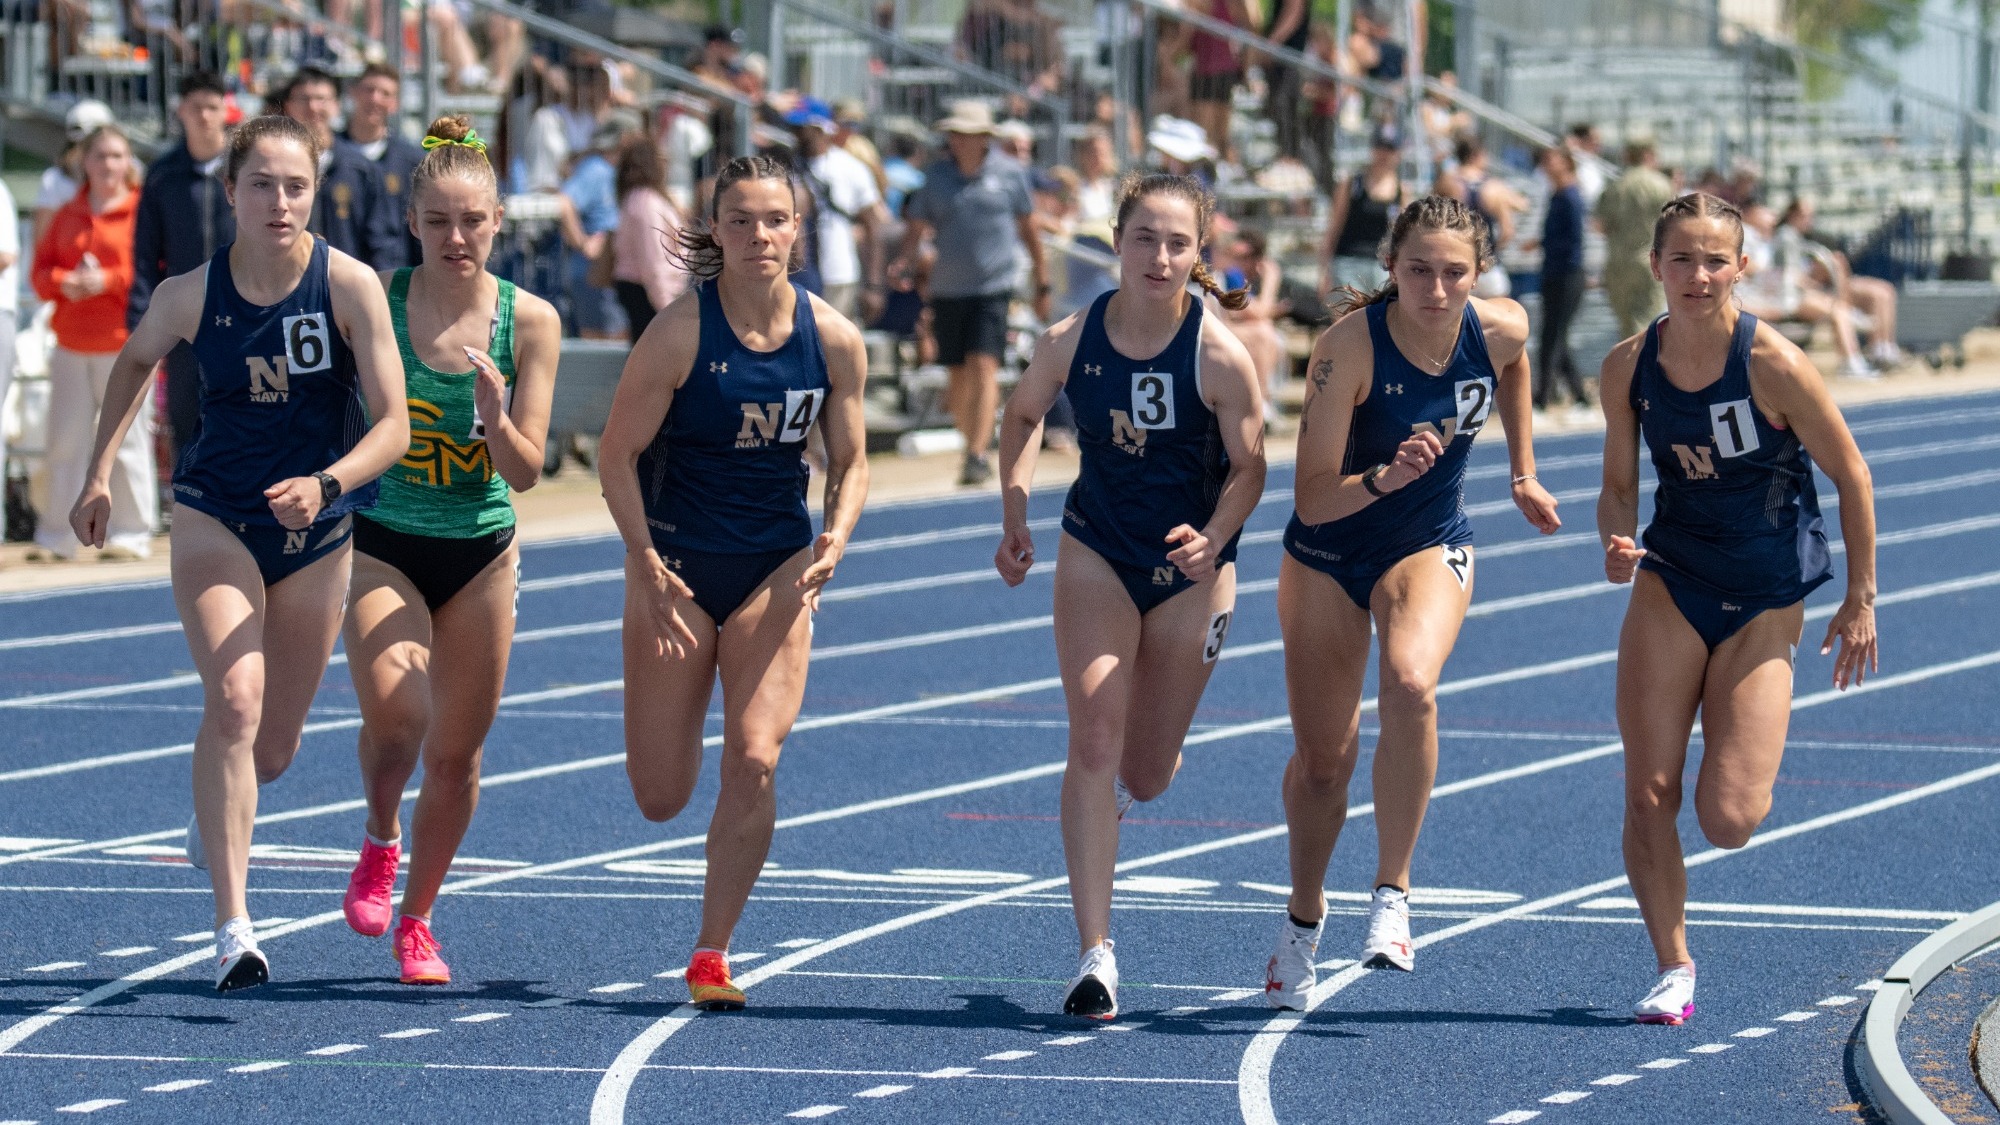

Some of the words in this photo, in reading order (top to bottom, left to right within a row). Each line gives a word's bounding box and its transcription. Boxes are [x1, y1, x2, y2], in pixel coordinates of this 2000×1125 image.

[290, 318, 324, 369] 6
[246, 355, 289, 394] N
[250, 391, 289, 402] NAVY
[787, 393, 812, 438] 4
[1137, 376, 1167, 426] 3
[1460, 383, 1487, 431] 2
[737, 403, 783, 439] N
[1109, 408, 1148, 447] N
[1718, 406, 1744, 453] 1
[734, 438, 770, 449] NAVY
[1671, 444, 1715, 474] N
[284, 531, 309, 549] N
[1152, 566, 1175, 582] N
[1721, 604, 1742, 612] NAVY
[1206, 612, 1228, 659] 3
